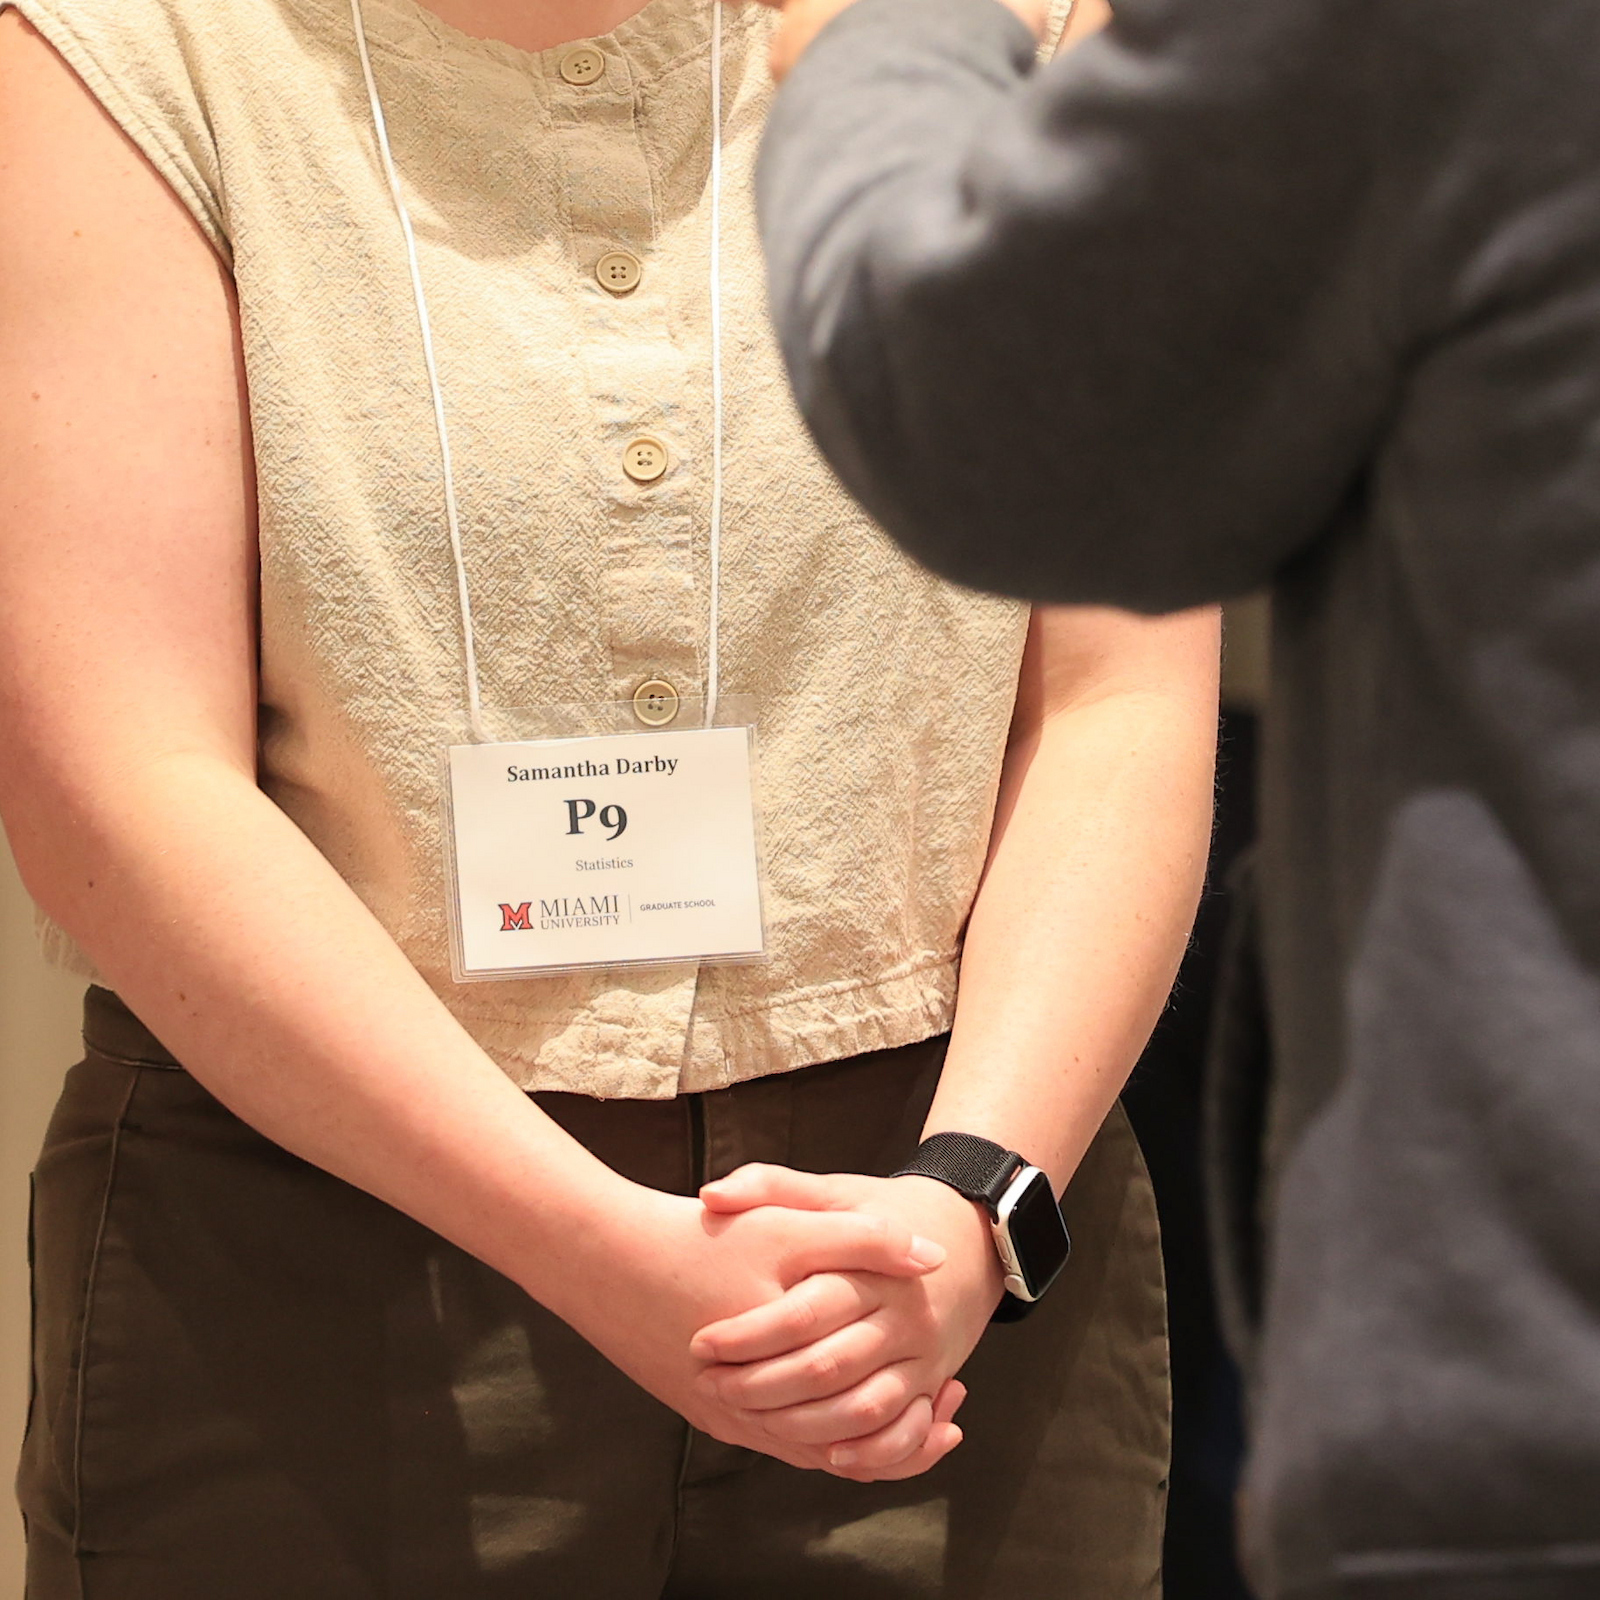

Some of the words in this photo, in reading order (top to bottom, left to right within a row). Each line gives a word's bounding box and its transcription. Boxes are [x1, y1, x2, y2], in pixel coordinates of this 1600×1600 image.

[507, 759, 609, 783] Samantha
[616, 755, 679, 776] Darby
[563, 798, 628, 841] P9
[575, 857, 634, 872] Statistics
[540, 894, 620, 918] MIAMI
[640, 901, 683, 912] GRADUATE
[684, 899, 716, 910] SCHOOL
[540, 915, 620, 930] UNIVERSITY
